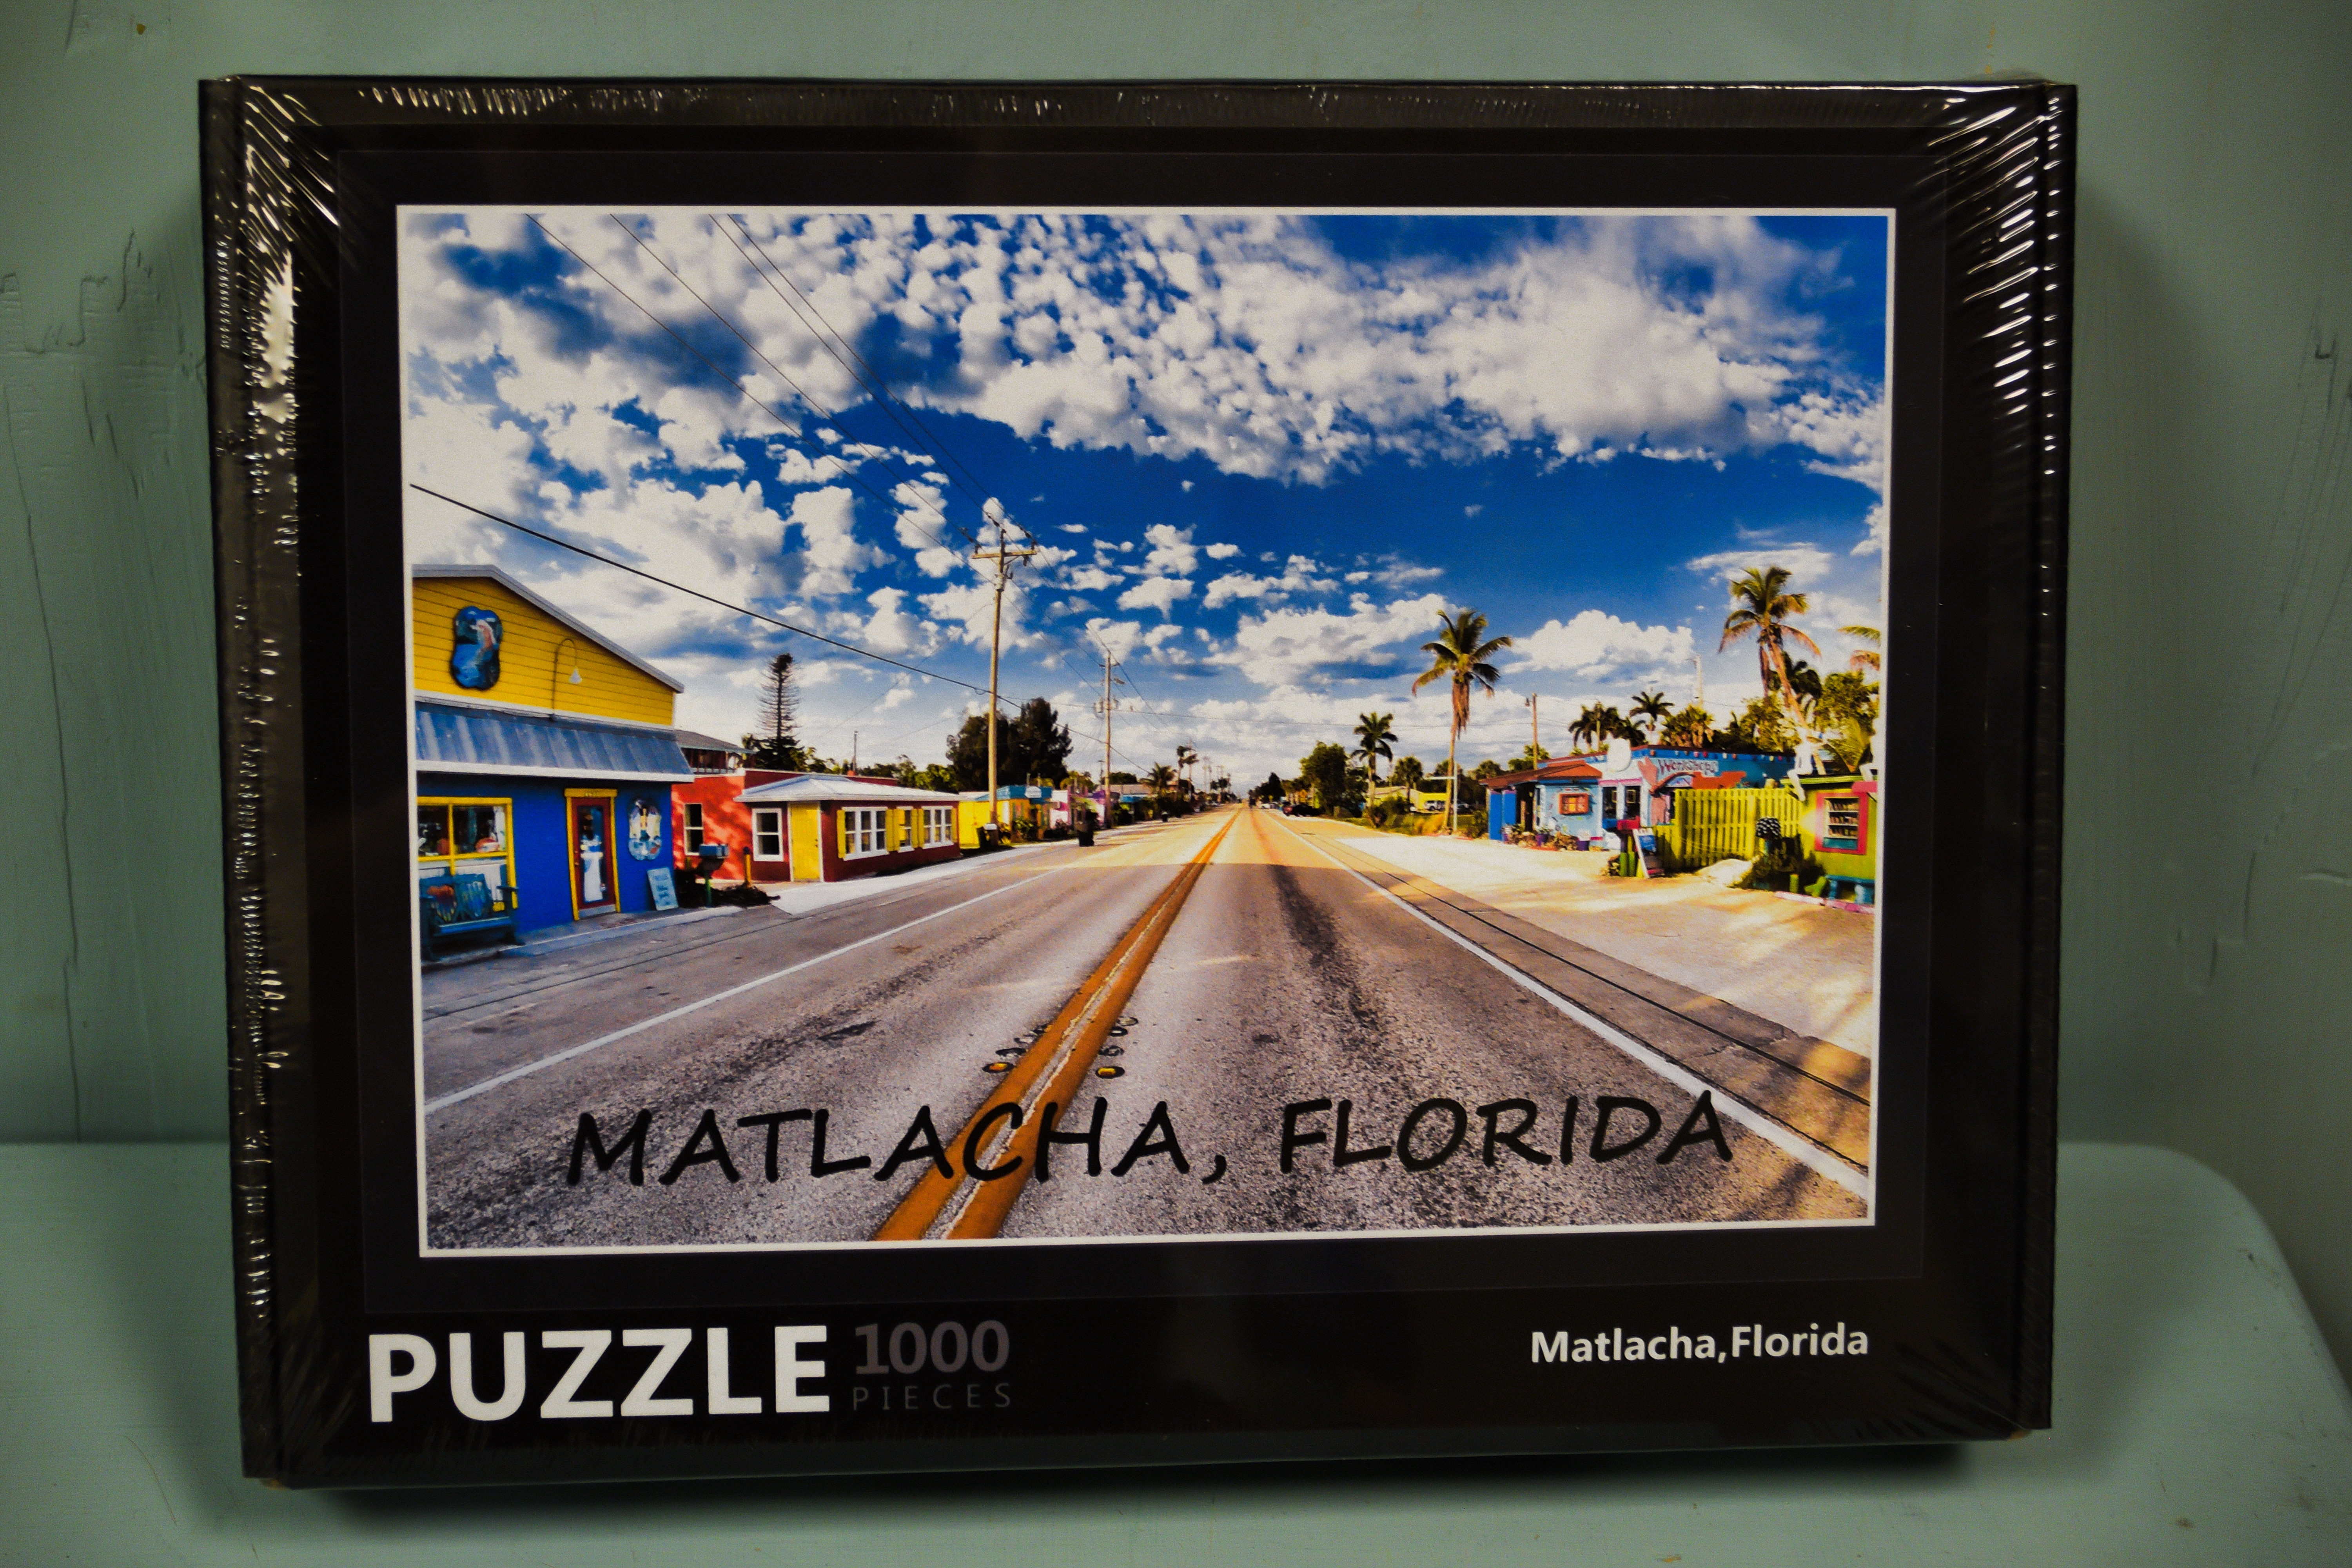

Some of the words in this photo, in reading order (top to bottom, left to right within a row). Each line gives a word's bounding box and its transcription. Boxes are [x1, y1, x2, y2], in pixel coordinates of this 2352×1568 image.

[566, 1097, 1227, 1187] MATLACHA,
[1280, 1090, 1732, 1174] FLORIDA
[368, 1325, 830, 1423] PUZZLE
[856, 1320, 1009, 1374] 1000
[853, 1383, 1010, 1410] PIECES
